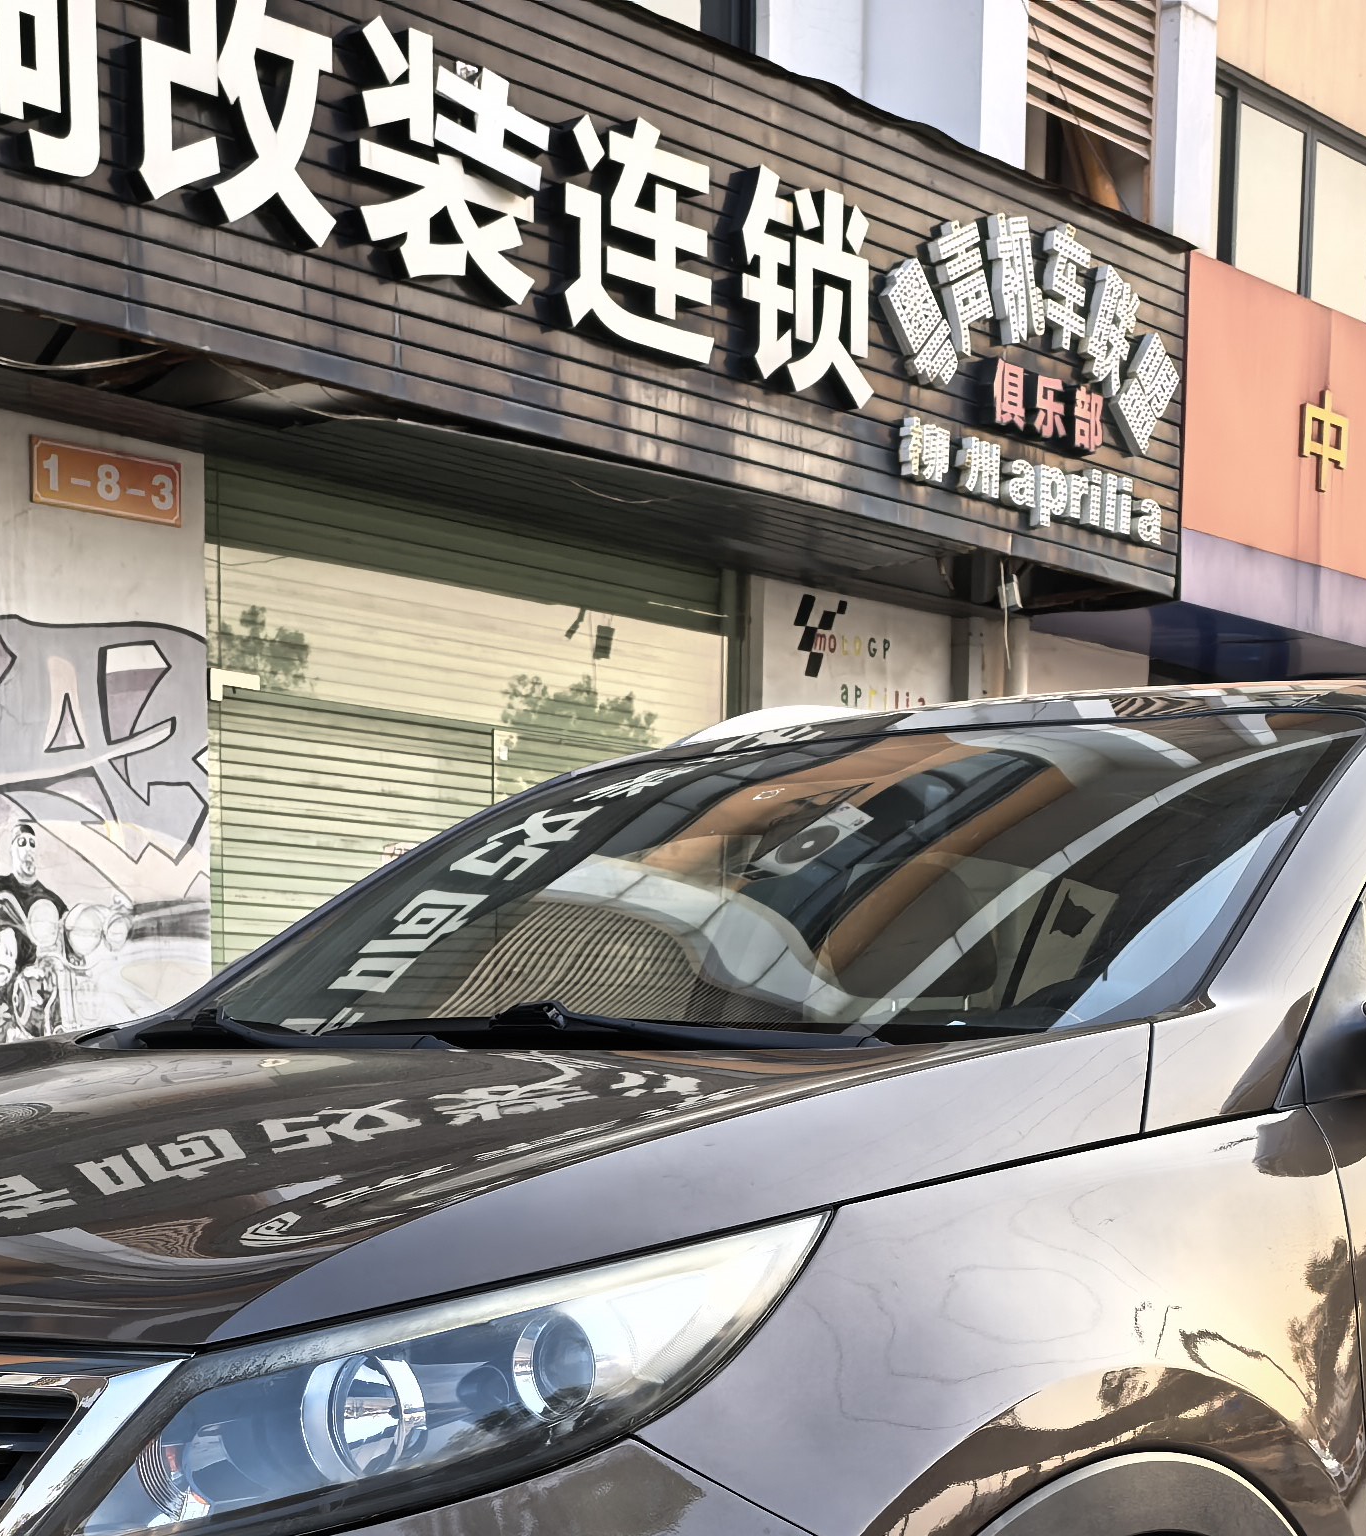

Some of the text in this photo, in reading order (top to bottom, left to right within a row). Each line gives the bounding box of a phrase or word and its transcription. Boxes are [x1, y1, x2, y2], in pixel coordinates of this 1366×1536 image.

[994, 358, 1105, 453] 俱乐部
[42, 453, 175, 511] 1-8-3
